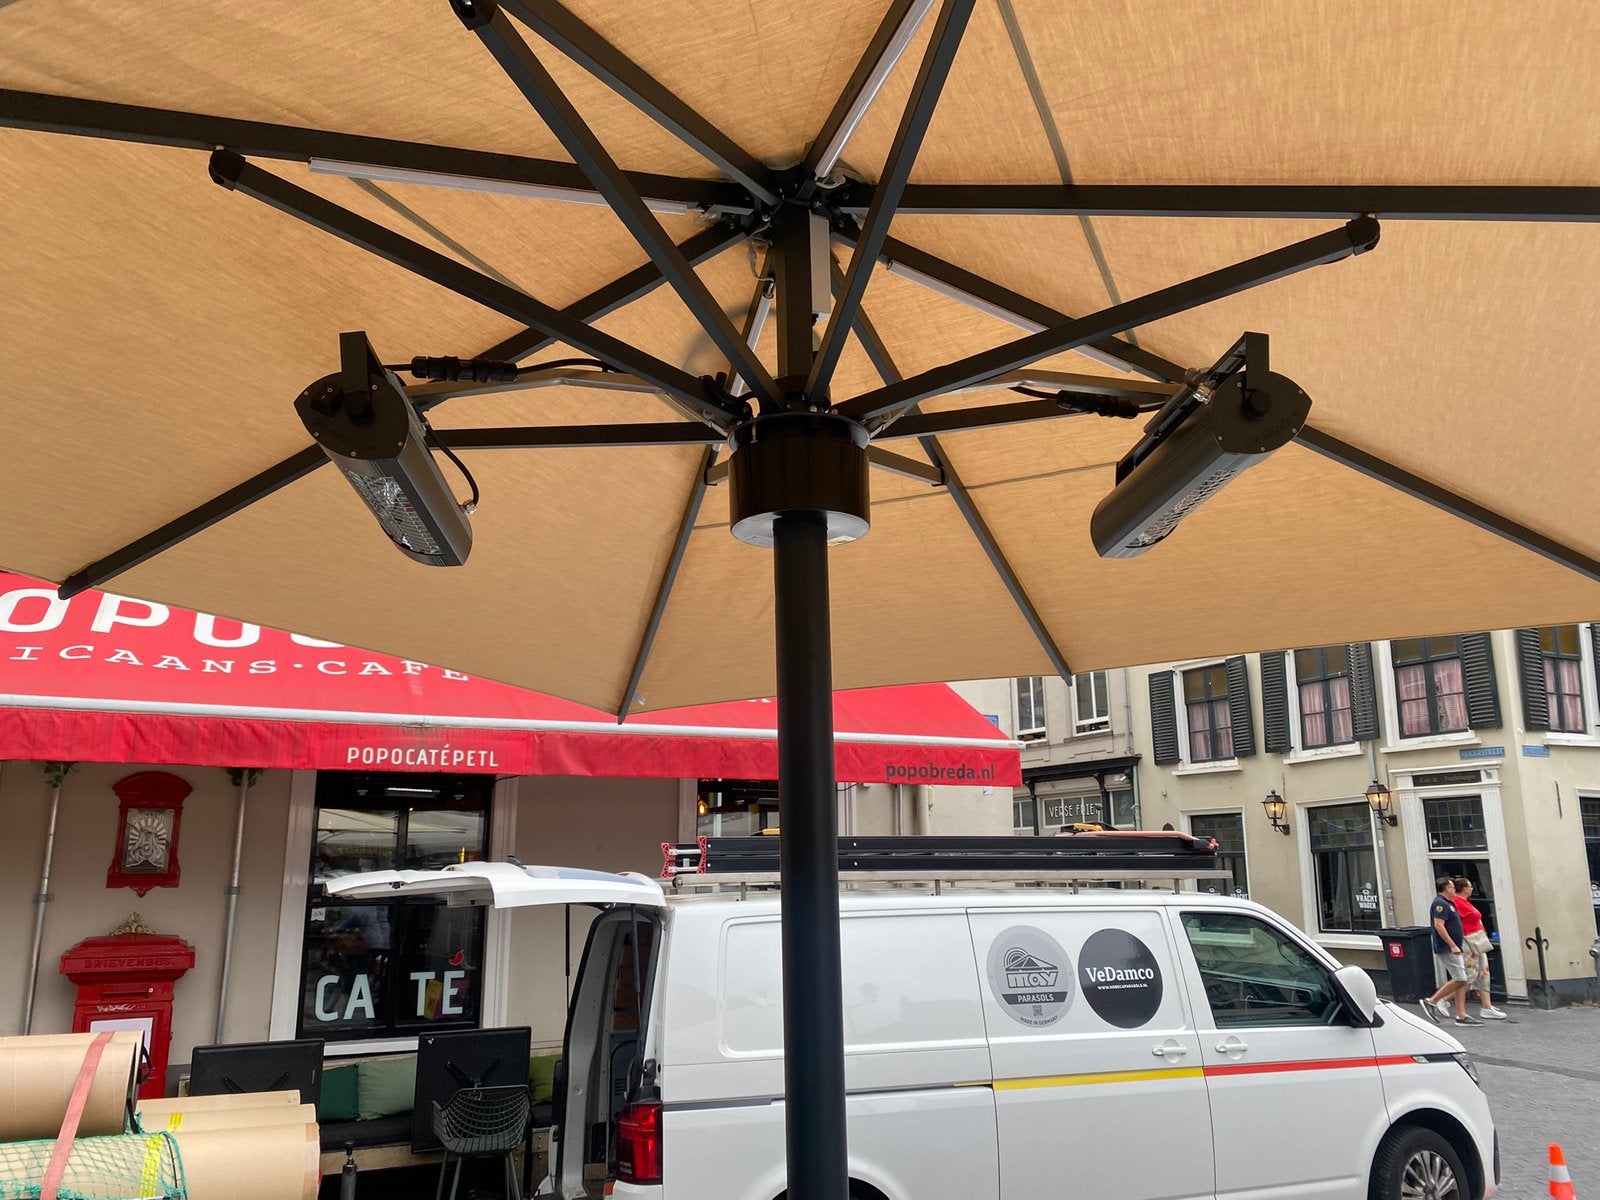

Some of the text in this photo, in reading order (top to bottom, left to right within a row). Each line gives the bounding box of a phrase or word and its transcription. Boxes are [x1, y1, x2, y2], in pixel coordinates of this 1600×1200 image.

[0, 588, 346, 648] OPO
[346, 743, 499, 768] POPOCATÉPETL
[885, 762, 995, 781] popobreda.nl
[1049, 805, 1073, 817] VERSE
[1085, 966, 1155, 983] VeDamco
[1017, 994, 1054, 1003] PARASOLS
[1020, 1016, 1033, 1026] MADE
[1039, 1016, 1058, 1025] GERMANY
